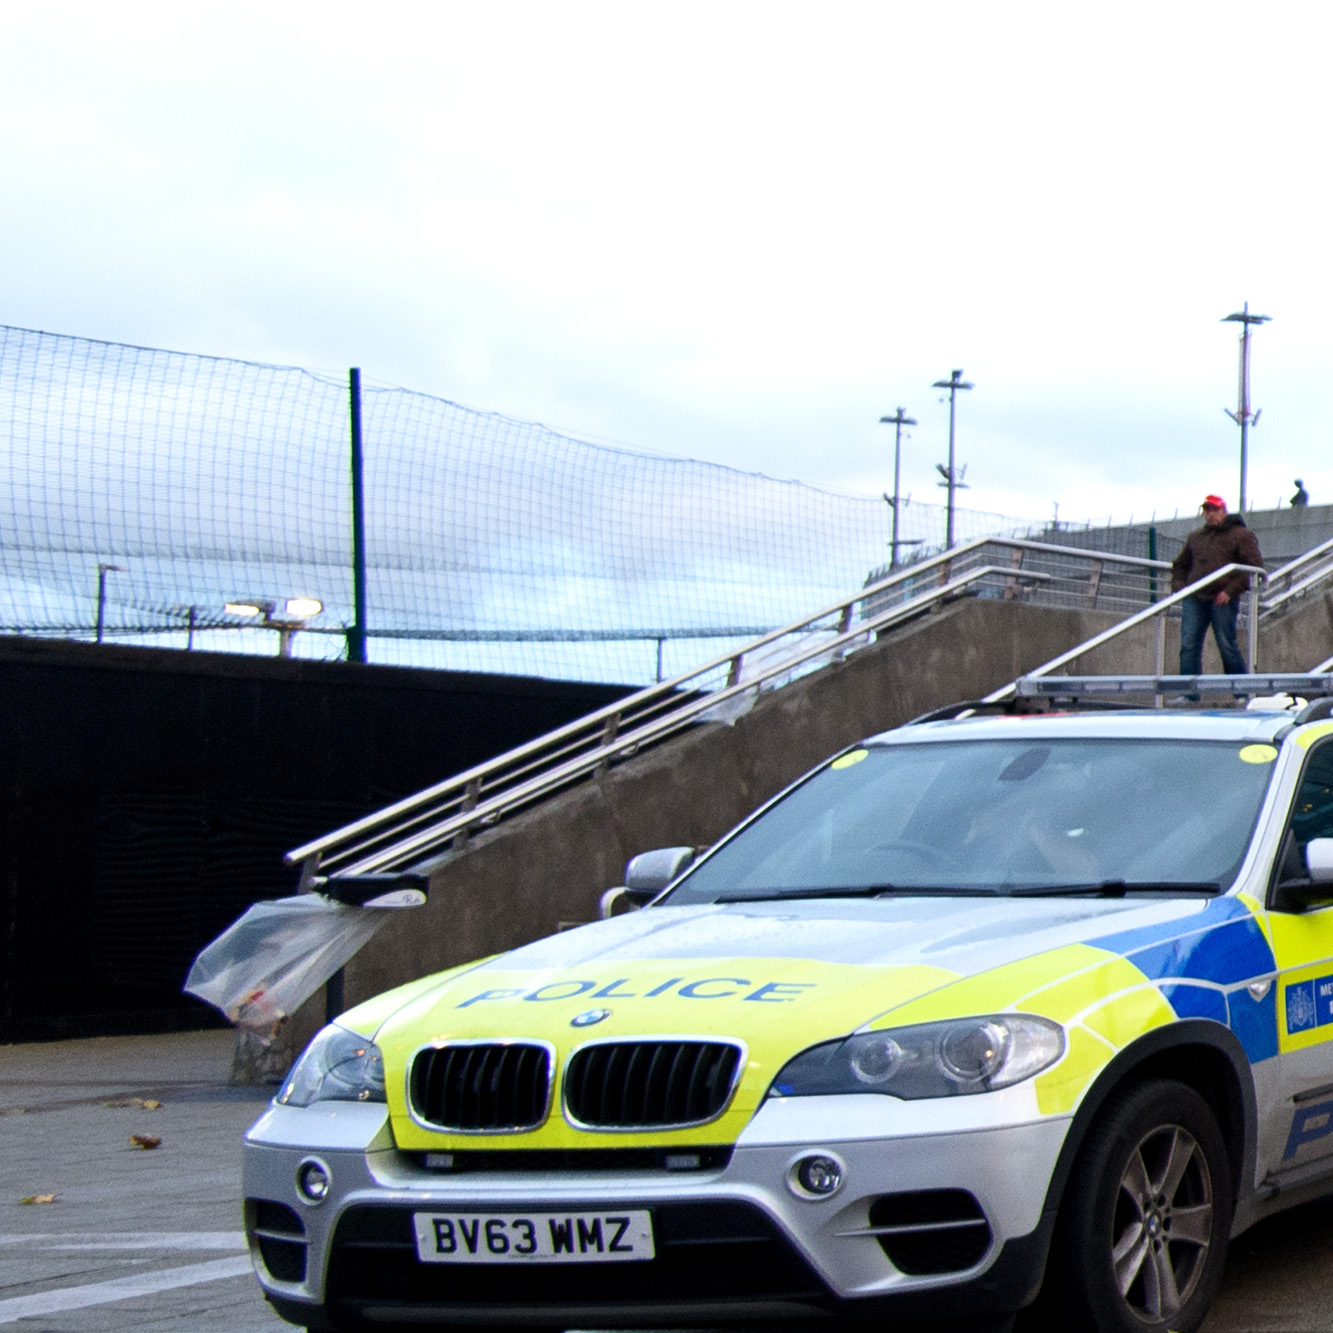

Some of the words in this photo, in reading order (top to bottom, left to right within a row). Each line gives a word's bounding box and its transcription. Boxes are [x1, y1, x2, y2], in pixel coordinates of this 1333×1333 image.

[454, 977, 818, 1009] POLICE
[432, 1218, 538, 1254] BV63
[549, 1217, 634, 1253] WMZ
